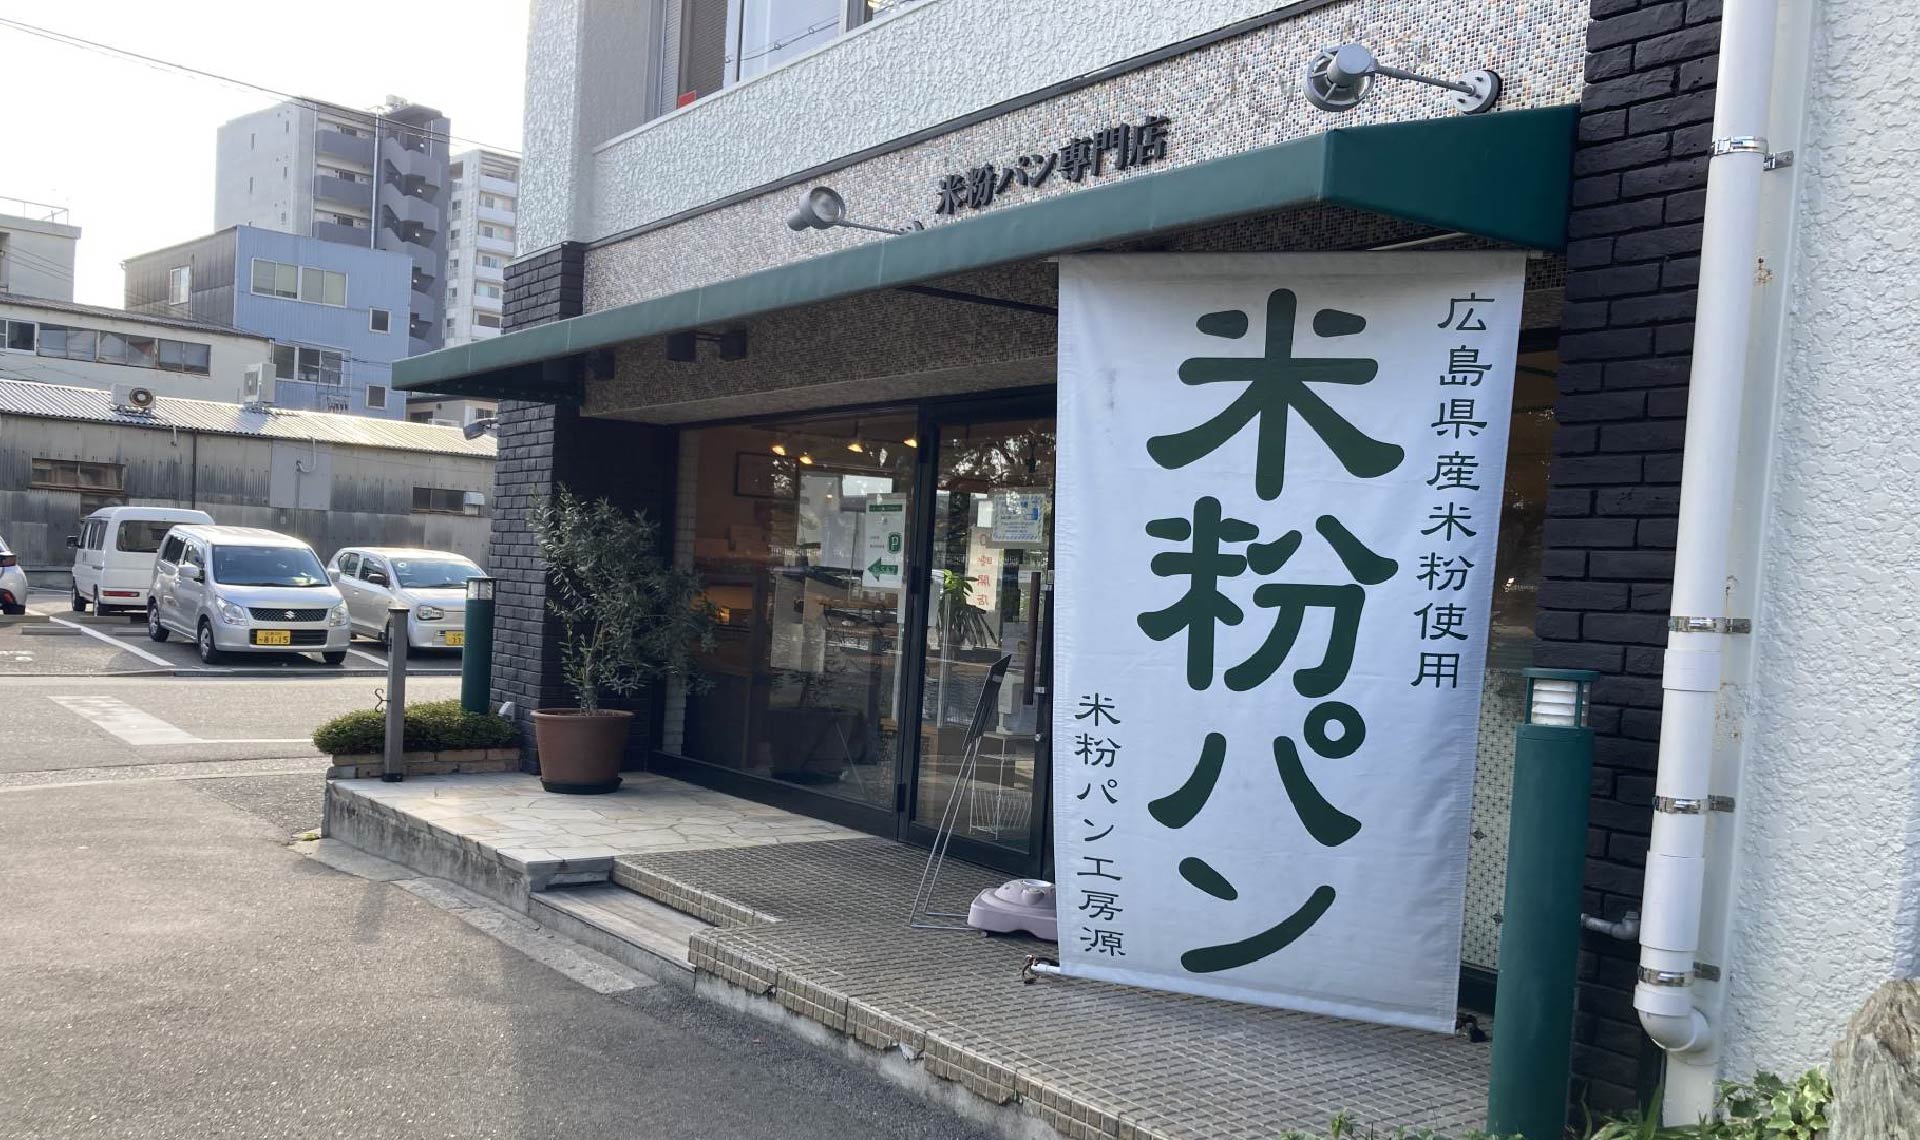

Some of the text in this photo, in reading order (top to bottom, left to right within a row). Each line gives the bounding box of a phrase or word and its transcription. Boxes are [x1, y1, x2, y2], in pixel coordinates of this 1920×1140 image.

[936, 115, 1170, 215] 米粉パン専門店
[1136, 288, 1404, 974] 米粉パン
[1411, 292, 1496, 690] 広島県産米粉使用
[1074, 692, 1126, 957] 米粉パン工房源
